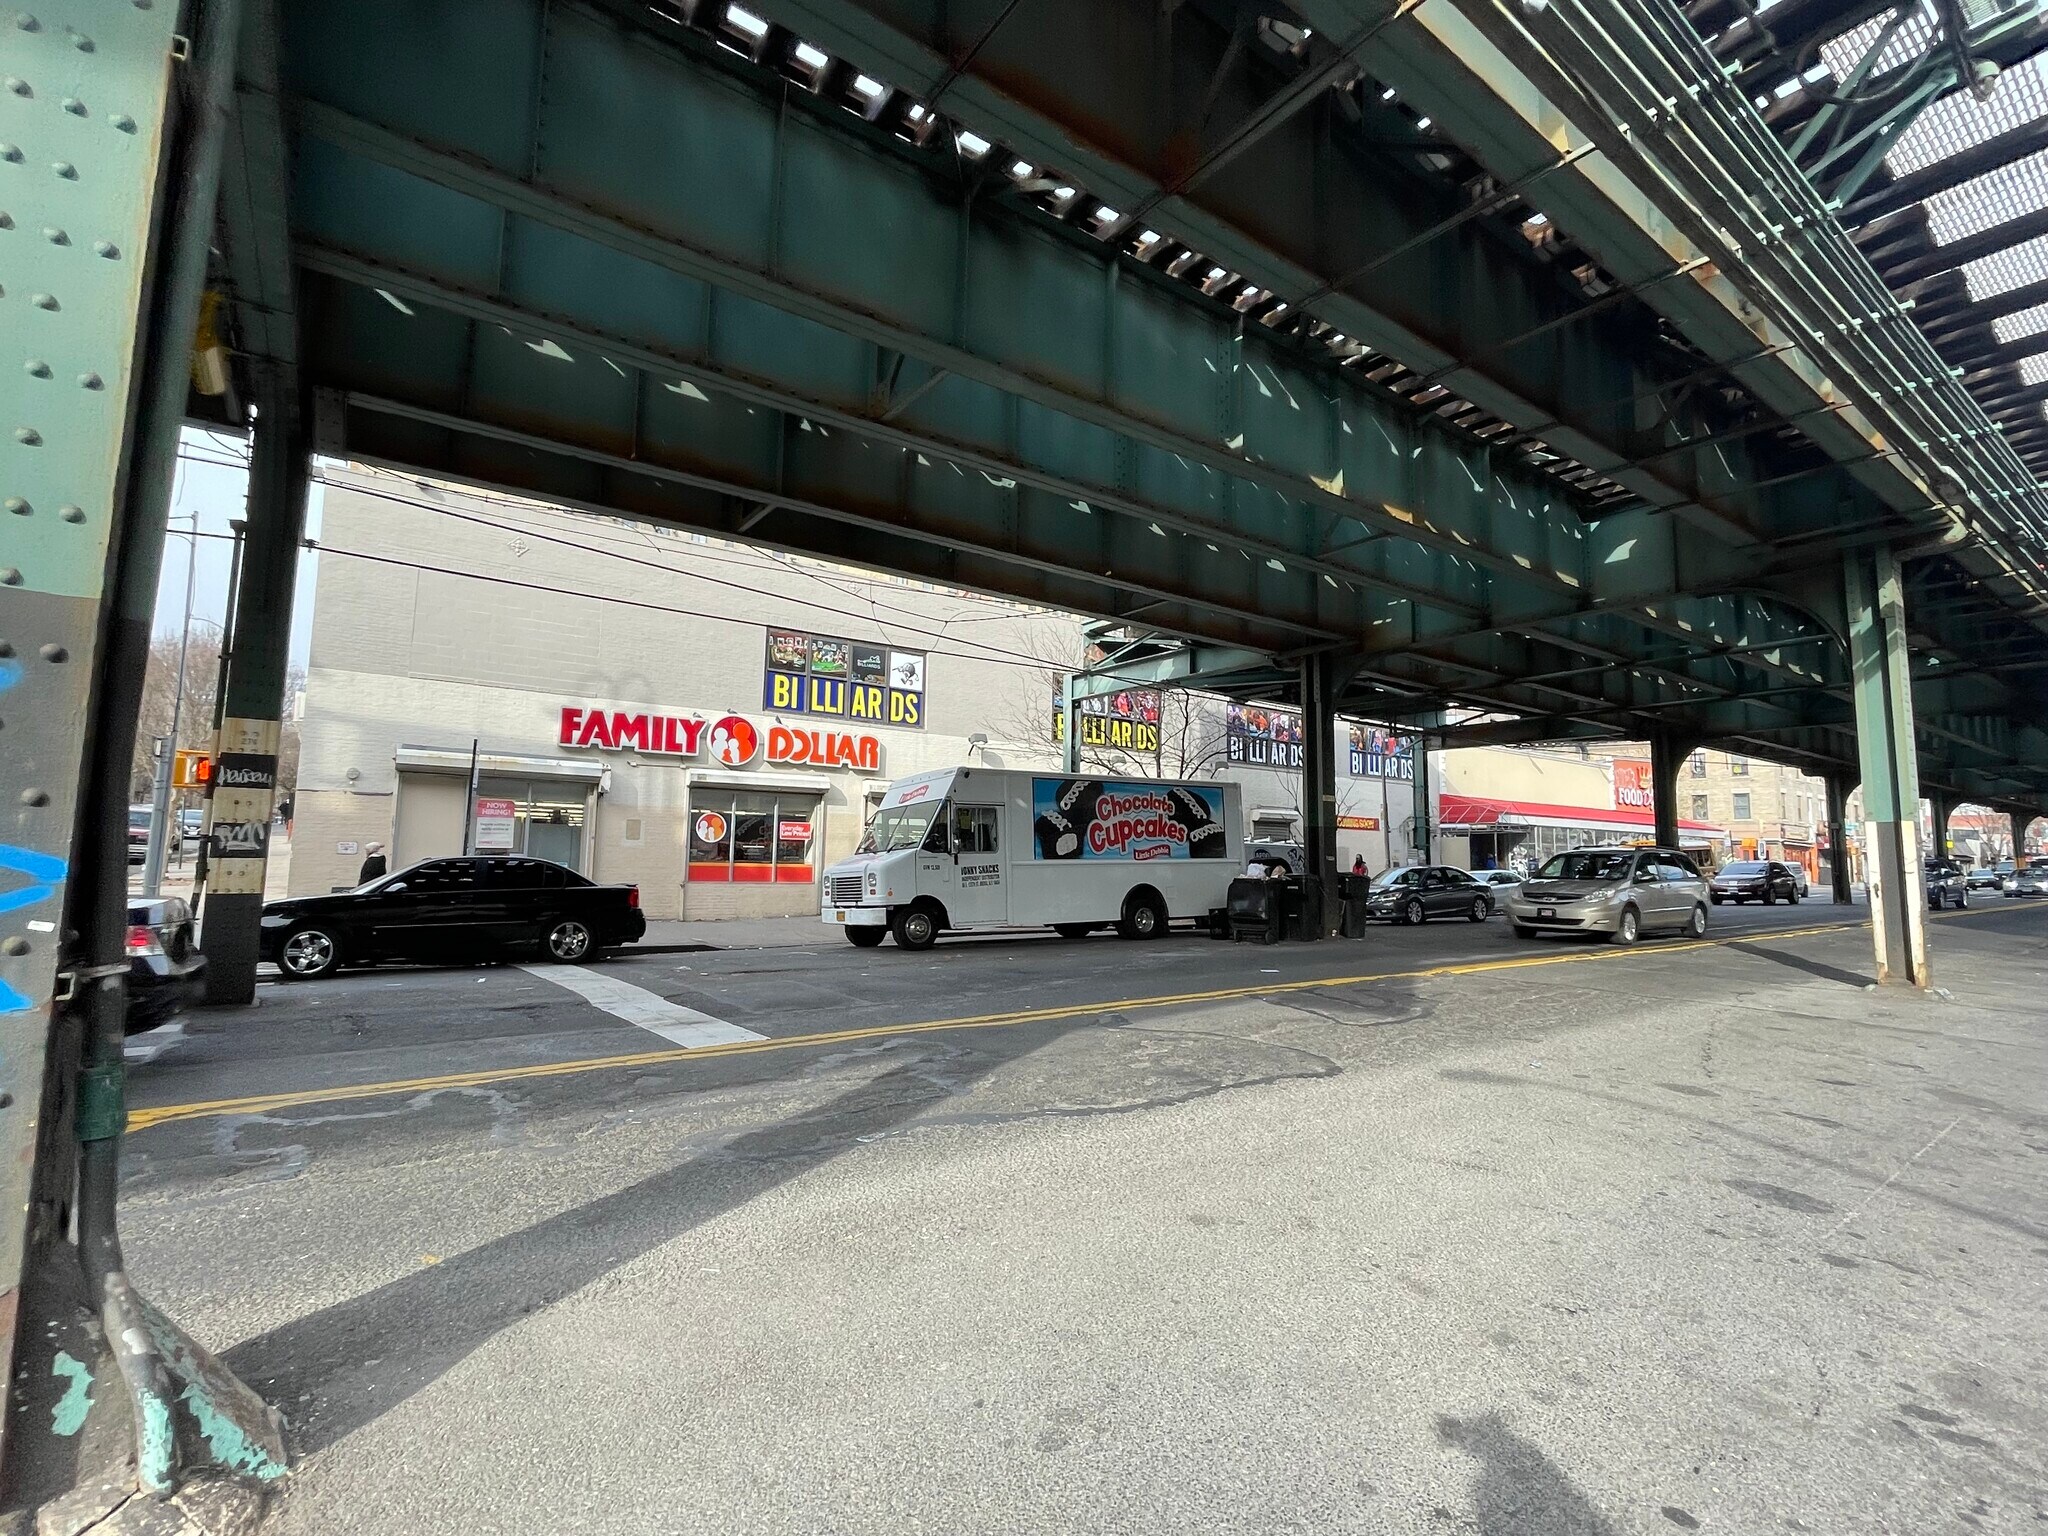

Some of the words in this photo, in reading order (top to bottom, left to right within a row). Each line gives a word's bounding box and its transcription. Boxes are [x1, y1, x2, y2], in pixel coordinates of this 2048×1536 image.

[560, 707, 706, 754] FAMILY
[766, 725, 880, 770] DOLLAR
[1056, 712, 1158, 752] BLLIARDS
[481, 808, 511, 816] HIRING!
[1096, 791, 1175, 822] Chocolate
[1618, 787, 1643, 806] FOOD
[1088, 813, 1186, 853] Cupcakes
